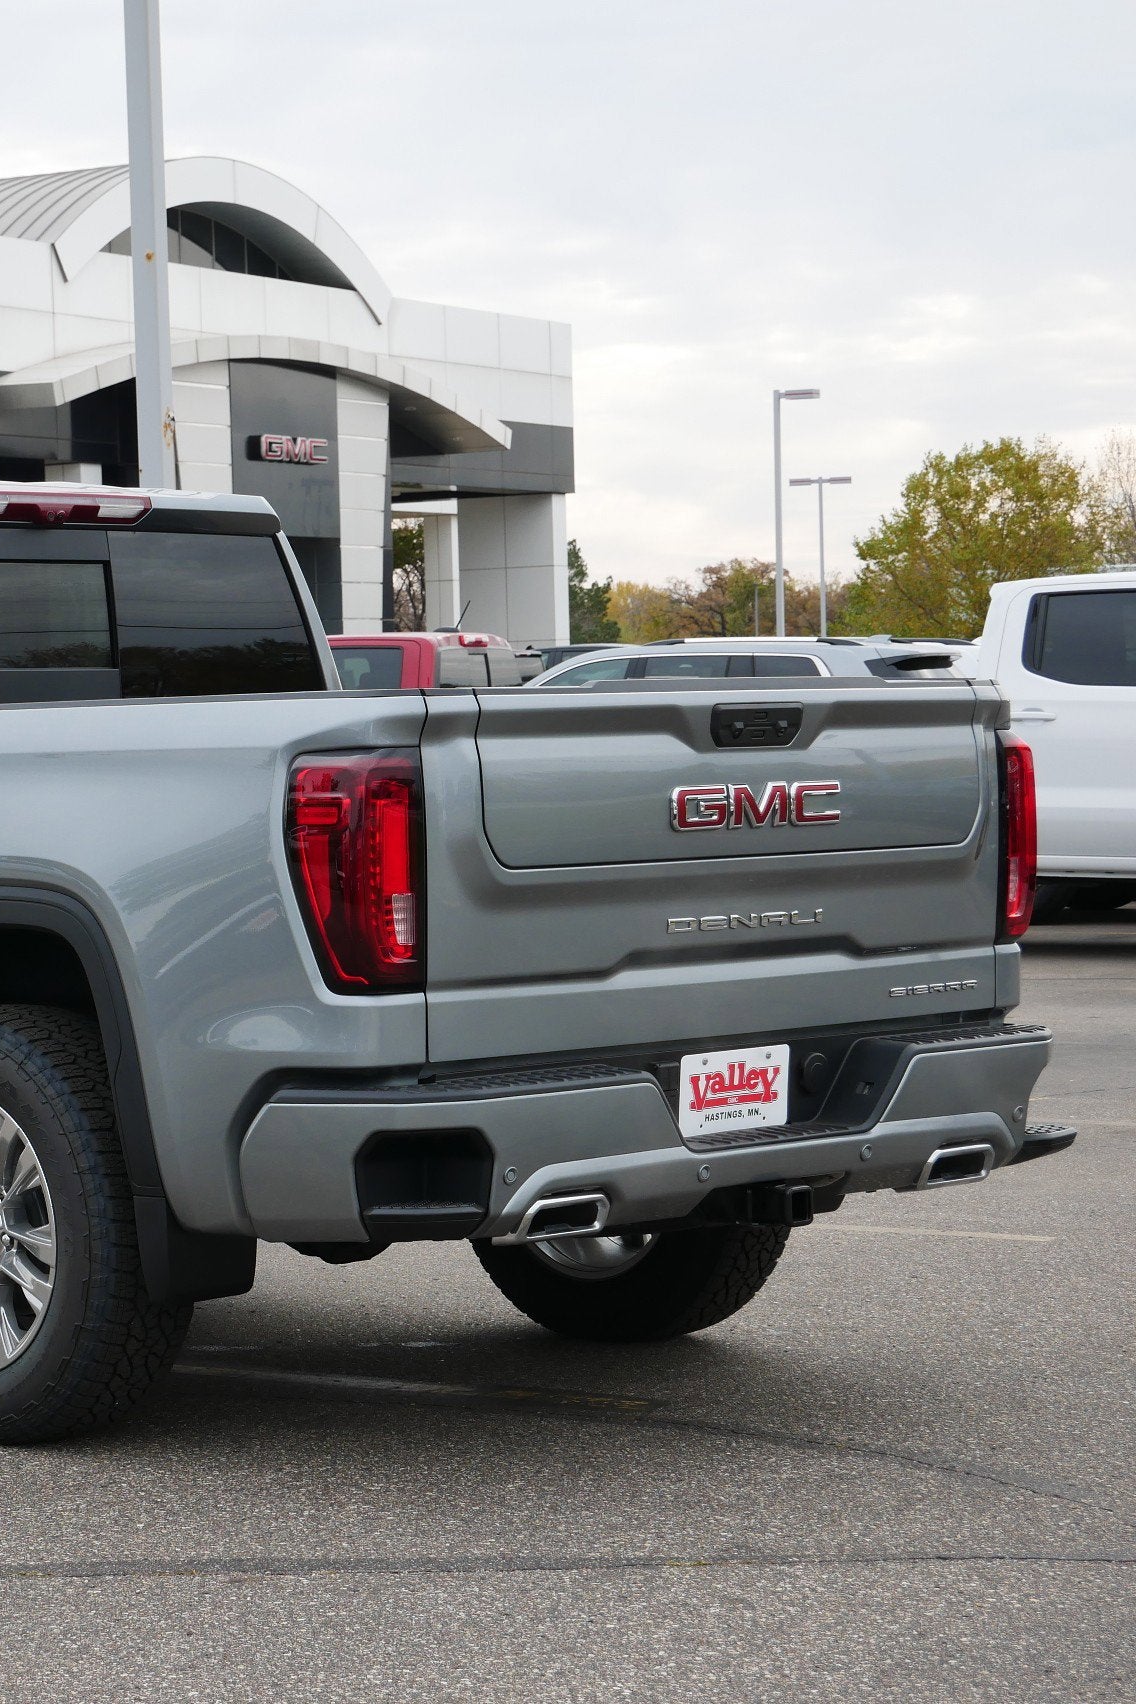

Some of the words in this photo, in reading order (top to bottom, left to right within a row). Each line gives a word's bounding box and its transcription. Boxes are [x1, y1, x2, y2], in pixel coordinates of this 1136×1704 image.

[260, 433, 328, 464] GMC
[670, 779, 841, 832] GMC
[666, 908, 823, 935] DENALI
[888, 979, 978, 998] SIERRA
[688, 1061, 781, 1112] Valley
[704, 1109, 744, 1122] HASTINGS,
[747, 1108, 762, 1117] MN.
